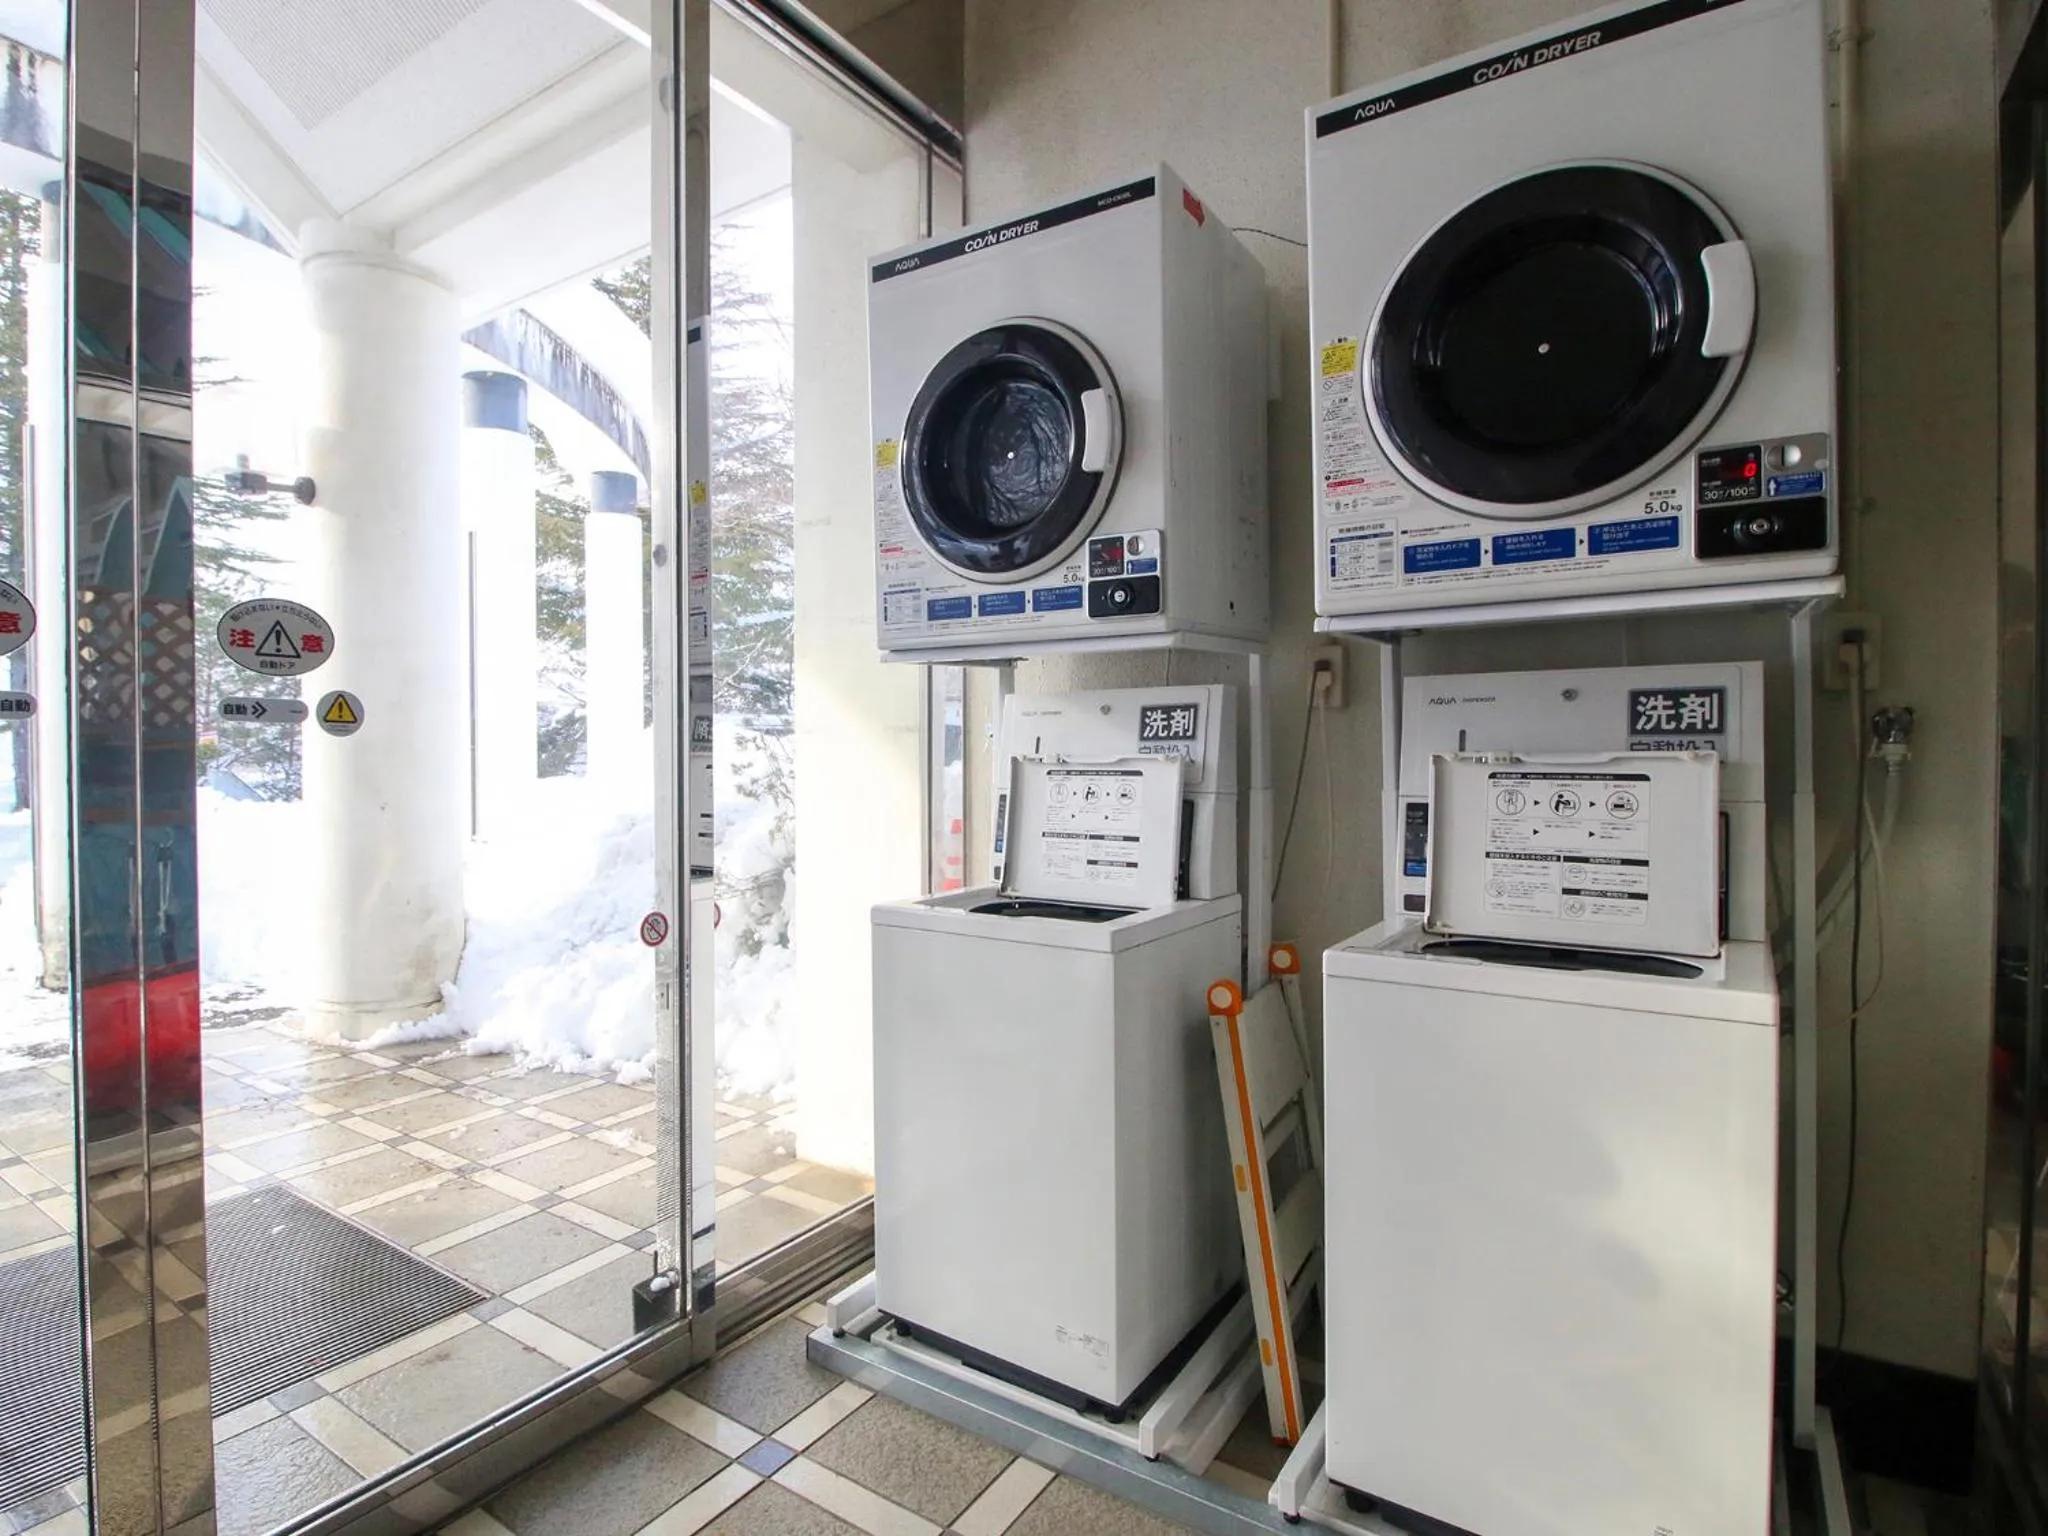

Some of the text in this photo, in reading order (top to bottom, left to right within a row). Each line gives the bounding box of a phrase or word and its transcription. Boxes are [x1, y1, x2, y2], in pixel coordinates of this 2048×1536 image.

[1354, 31, 1601, 120] AQUA COIN DRYER
[894, 257, 920, 272] AQUA
[999, 219, 1039, 242] DRYER
[1744, 462, 1758, 478] 0
[229, 627, 325, 654] 注 意
[1, 699, 31, 713] 自動
[223, 702, 248, 716] 自動
[1635, 692, 1719, 731] 洗剤
[1143, 708, 1195, 738] 洗剤
